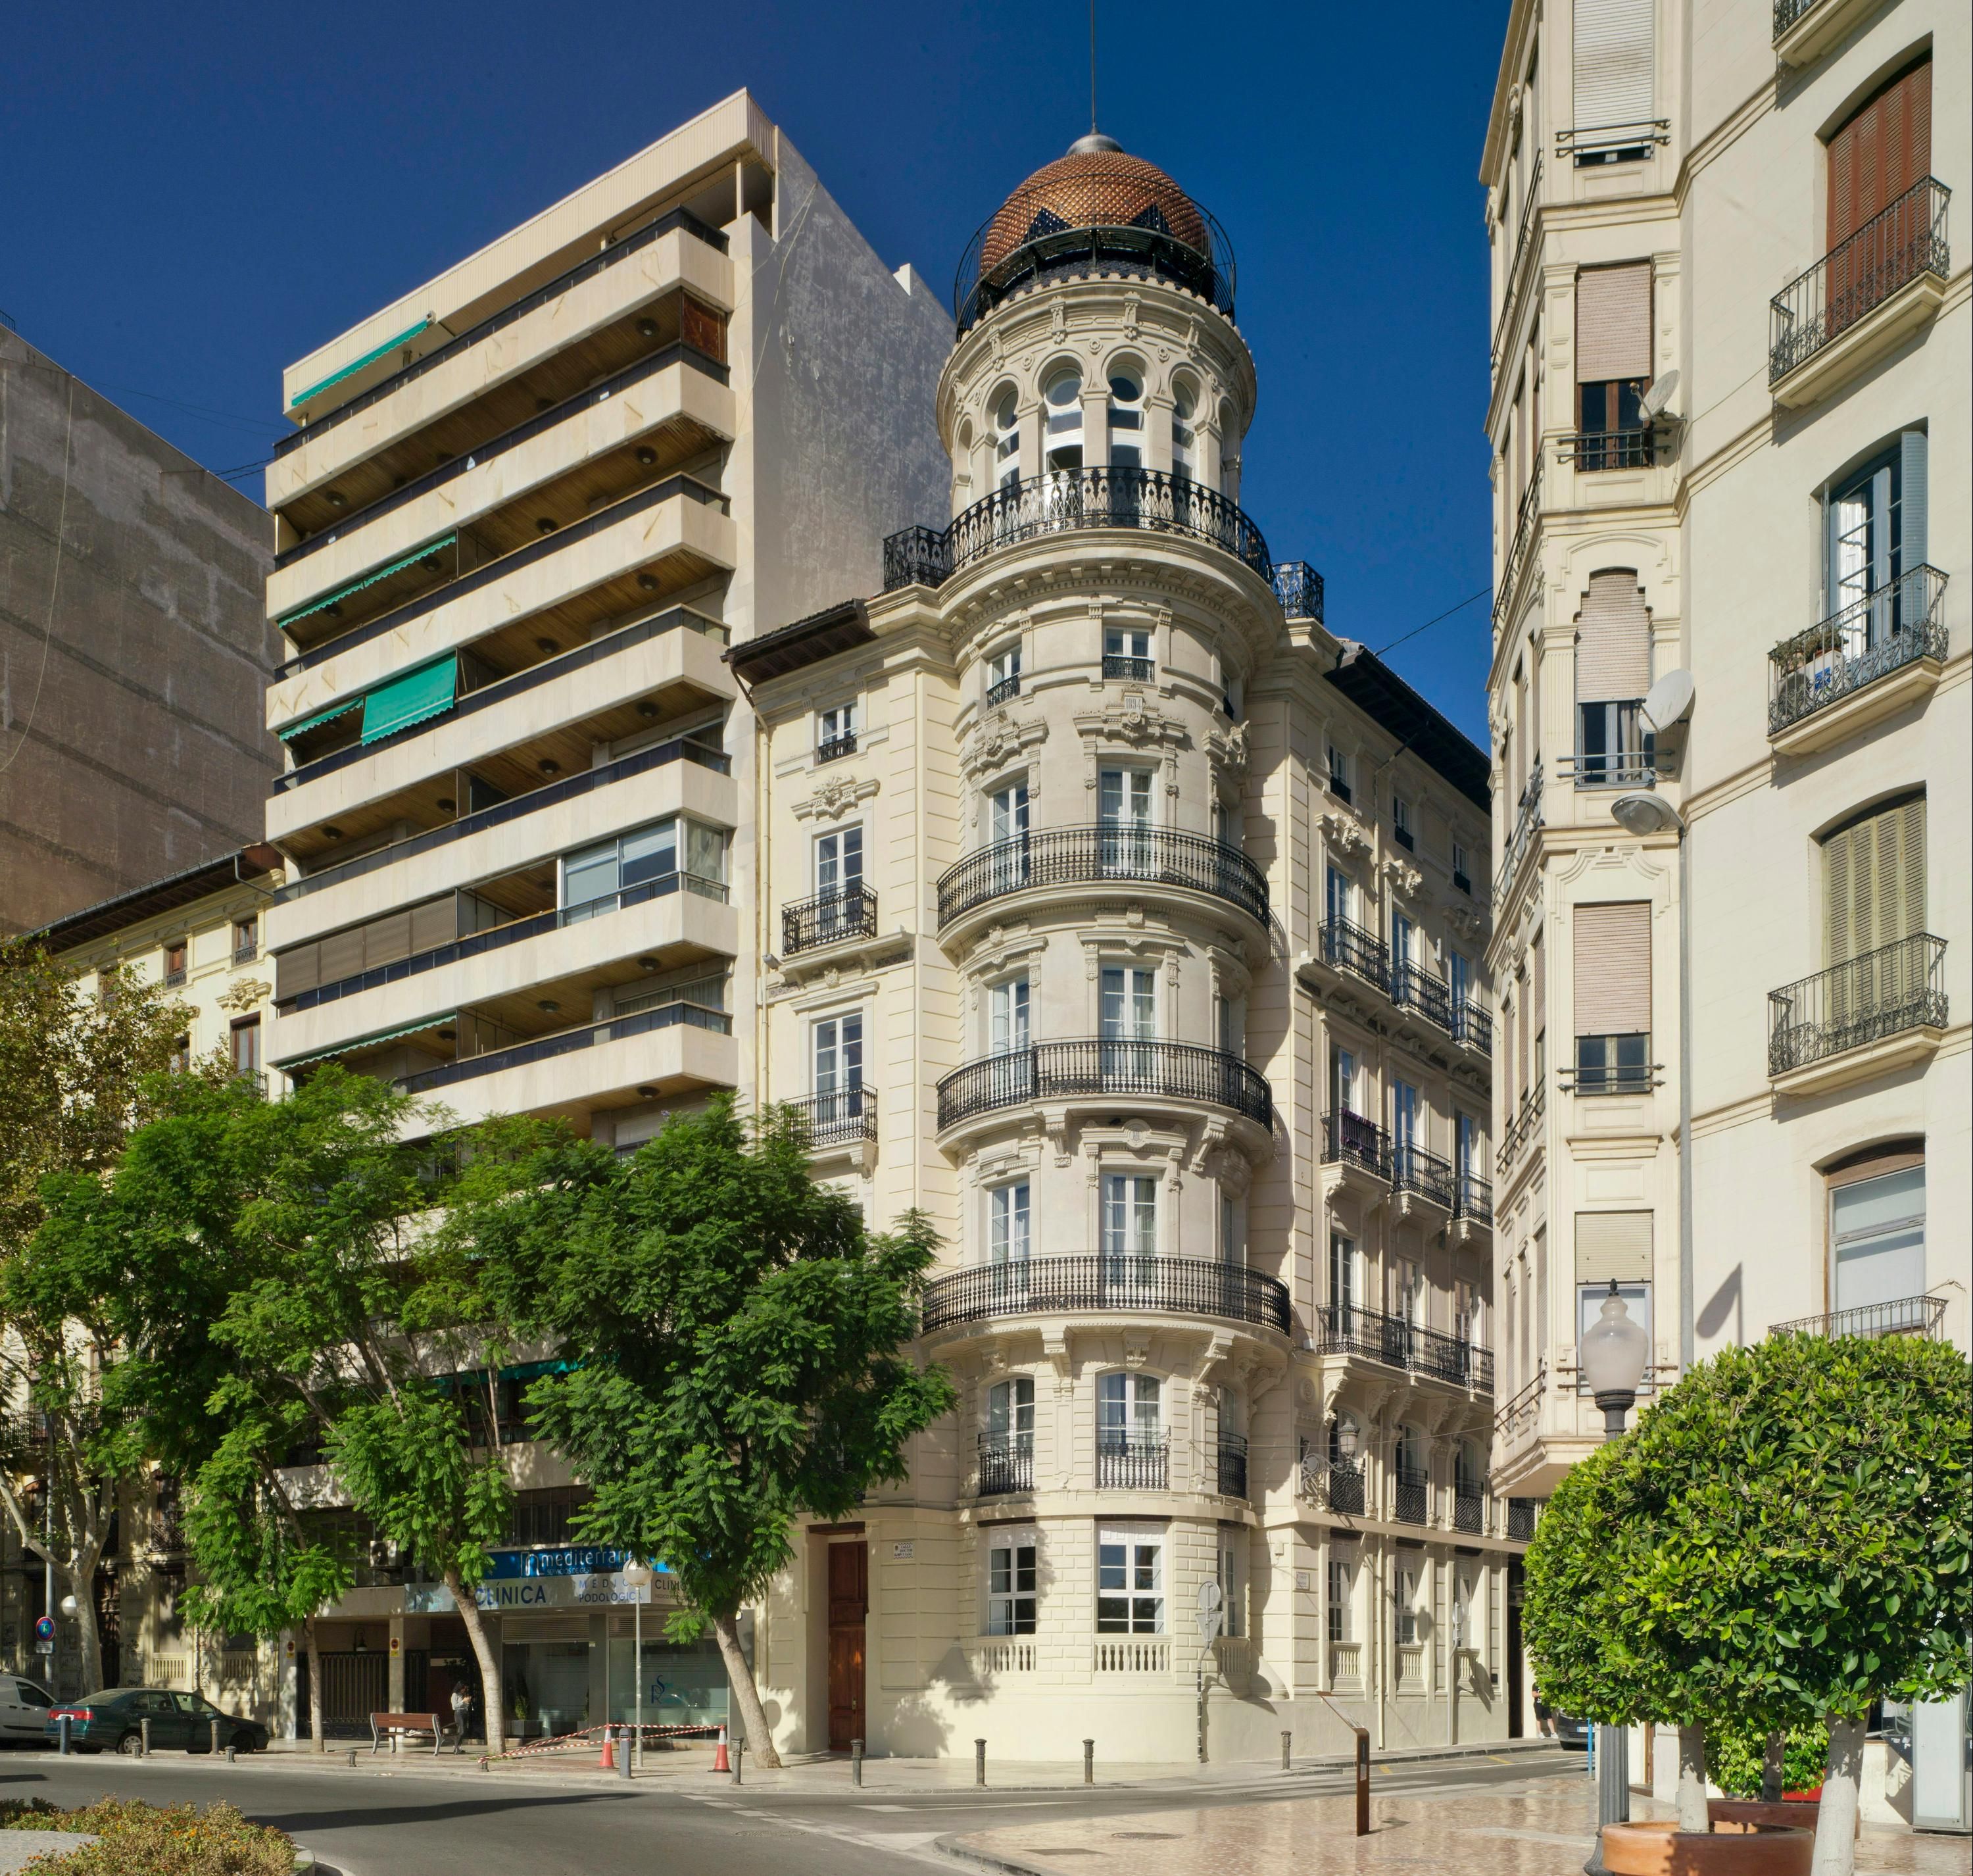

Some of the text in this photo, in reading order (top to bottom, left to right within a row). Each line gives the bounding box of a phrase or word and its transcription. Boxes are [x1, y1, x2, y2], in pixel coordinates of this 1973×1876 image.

[541, 1548, 632, 1567] mediterrane
[579, 1578, 629, 1589] MEDIC
[474, 1581, 547, 1606] CLÍNICA
